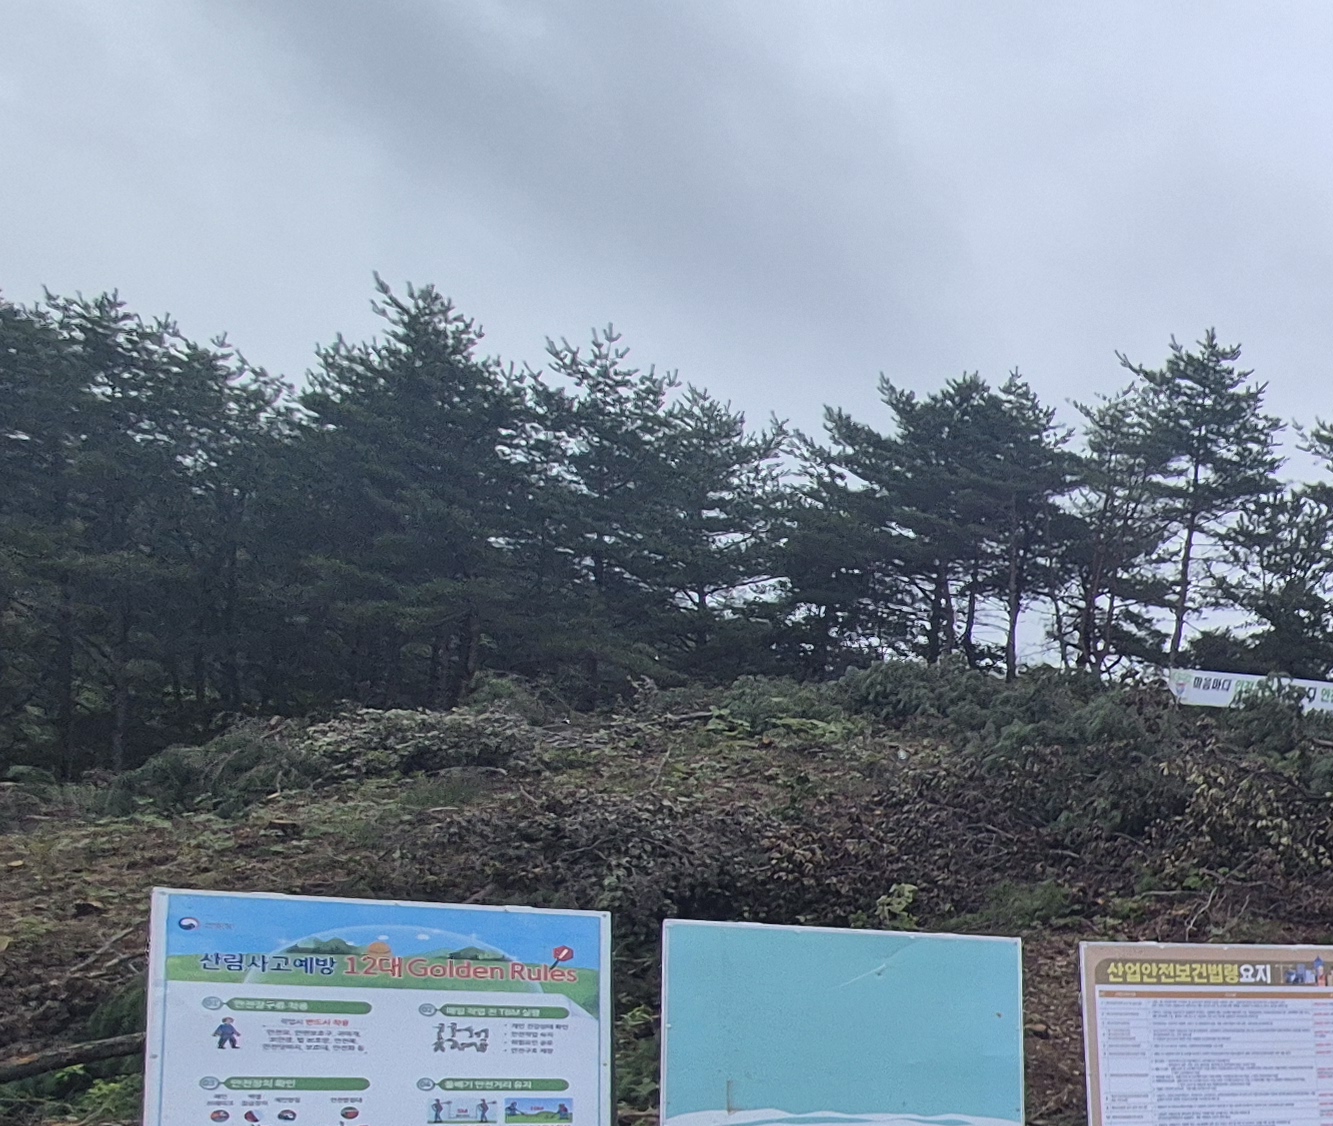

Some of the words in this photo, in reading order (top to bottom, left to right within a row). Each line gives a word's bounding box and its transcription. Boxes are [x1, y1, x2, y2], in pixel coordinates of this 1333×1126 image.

[200, 952, 337, 975] 산림사고예방
[344, 956, 403, 978] 12대
[407, 958, 504, 980] Golden
[510, 962, 578, 983] Rules
